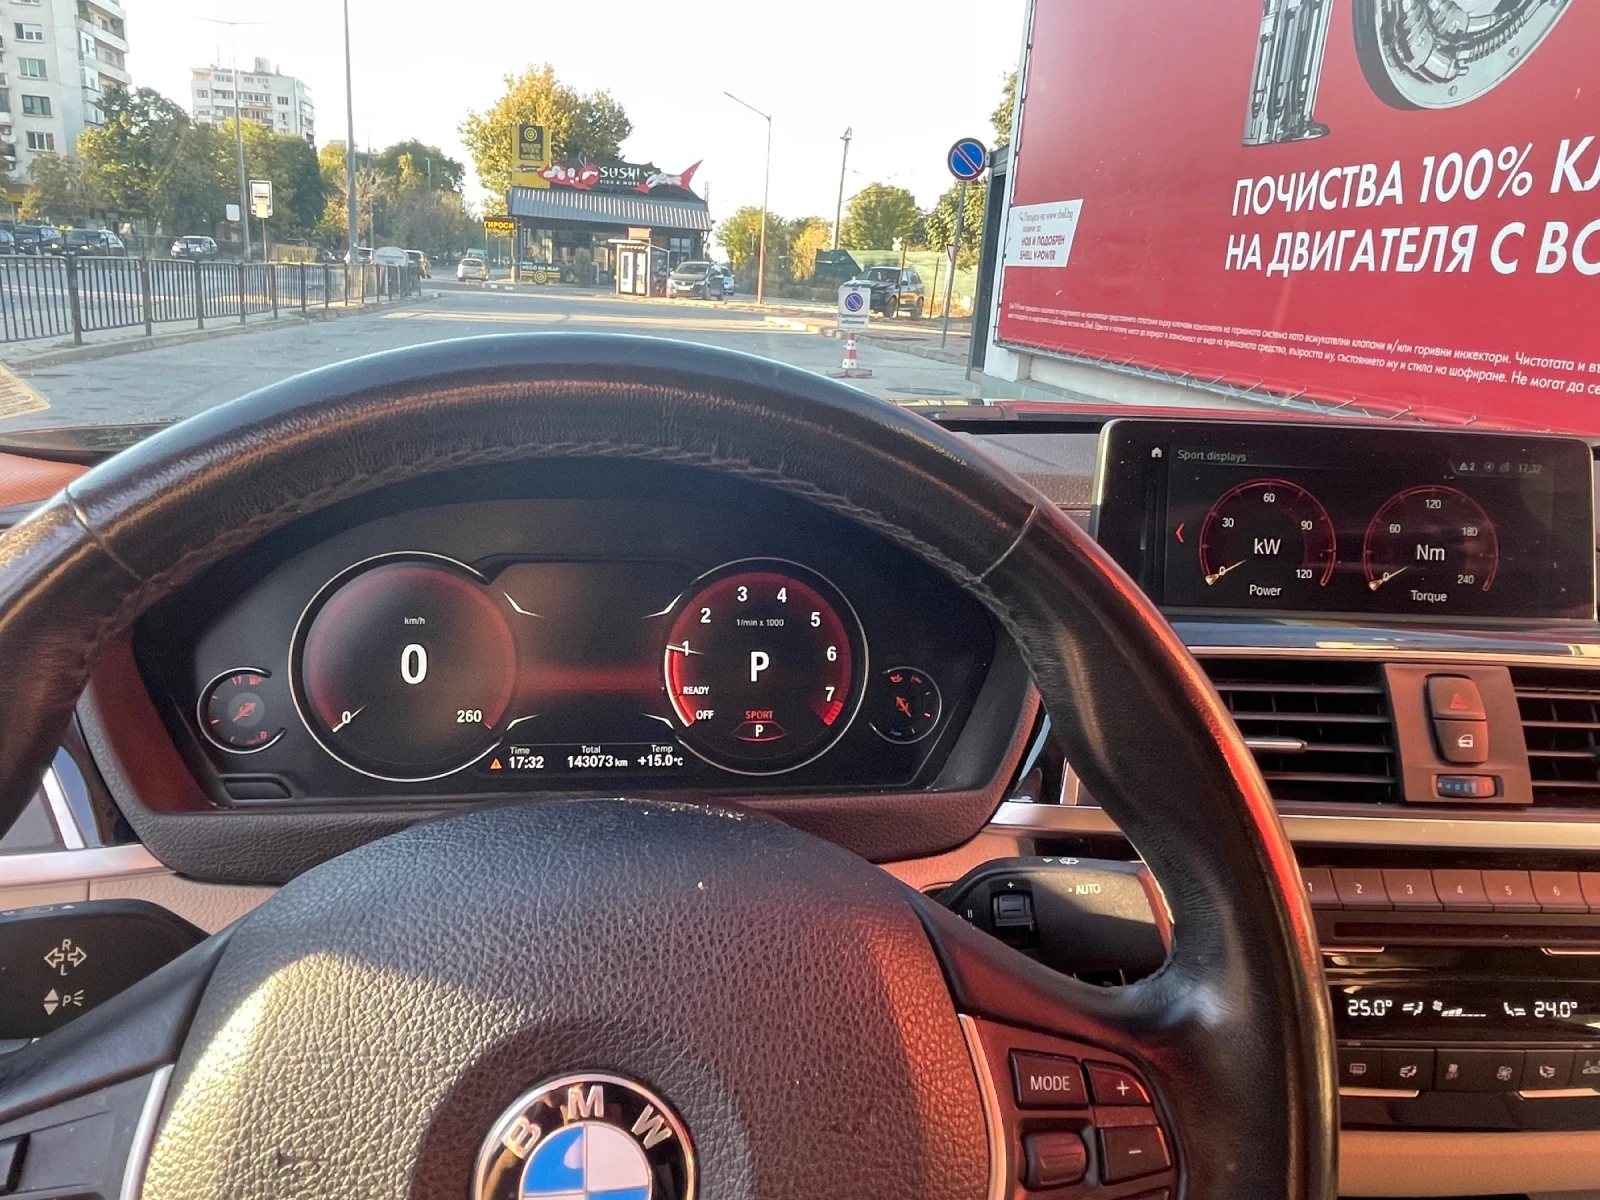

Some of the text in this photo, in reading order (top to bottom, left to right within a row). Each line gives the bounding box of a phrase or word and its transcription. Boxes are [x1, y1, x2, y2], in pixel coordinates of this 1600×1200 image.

[600, 166, 640, 180] SUSHI
[1232, 160, 1403, 216] ПОЧИСТВА
[1419, 142, 1533, 203] 100%
[484, 221, 514, 229] ГИРОСИ
[1225, 234, 1262, 271] НА
[1266, 224, 1478, 277] ДВИГАТЕЛЯ
[1490, 222, 1526, 276] С
[1289, 332, 1304, 341] като
[1305, 334, 1351, 346] всмукателни
[1352, 340, 1386, 351] клапани
[1387, 339, 1412, 354] и/или
[1414, 345, 1452, 358] горивни
[1454, 349, 1511, 366] инжектори.
[1515, 351, 1575, 371] Чистотата
[1577, 362, 1586, 373] и
[1337, 353, 1386, 367] състоянието
[1386, 361, 1400, 372] му
[1407, 362, 1432, 373] стила
[1434, 365, 1447, 375] на
[1449, 366, 1507, 383] шофиране.
[1511, 371, 1528, 385] Не
[1530, 376, 1566, 390] могат
[1566, 380, 1584, 393] да
[1177, 449, 1247, 463] Sport displays
[1469, 462, 1475, 471] 2
[1263, 493, 1276, 503] 60
[1425, 499, 1442, 510] 120
[1221, 518, 1235, 528] 30
[1300, 520, 1313, 531] 90
[1389, 524, 1401, 534] 60
[1461, 527, 1478, 537] 180
[1253, 538, 1281, 555] kW
[1416, 545, 1445, 561] Nm
[1295, 569, 1313, 580] 120
[1457, 574, 1474, 585] 240
[737, 587, 748, 602] 3
[776, 587, 788, 603] 4
[1249, 584, 1281, 599] Power
[1411, 590, 1447, 604] Torque
[404, 616, 426, 626] km/h
[700, 608, 712, 623] 2
[810, 611, 821, 627] 5
[736, 618, 758, 628] 1/min
[766, 618, 785, 627] 1000
[826, 646, 837, 661] 6
[401, 644, 428, 685] 0
[750, 651, 770, 682] P
[683, 686, 709, 696] READY
[825, 687, 835, 702] 7
[342, 711, 352, 724] 0
[456, 710, 482, 723] 260
[695, 709, 714, 720] OFF
[745, 710, 773, 720] SPORT
[755, 725, 764, 737] P
[509, 746, 531, 754] Time
[581, 745, 601, 754] Total
[651, 744, 673, 753] Temp
[509, 755, 544, 769] 17:32
[567, 755, 613, 768] 143073
[1076, 883, 1101, 895] AUTO
[1307, 882, 1313, 892] 1
[1355, 884, 1363, 894] 2
[1406, 885, 1413, 895] 3
[1457, 885, 1464, 895] 4
[1505, 886, 1512, 896] 5
[1553, 887, 1560, 896] 6
[62, 939, 71, 951] R
[60, 965, 67, 976] L
[62, 995, 71, 1007] P
[1347, 999, 1393, 1017] 25.0°
[1534, 1001, 1578, 1018] 24.0°
[1030, 1075, 1071, 1092] MODE
[502, 1085, 672, 1159] BMW
